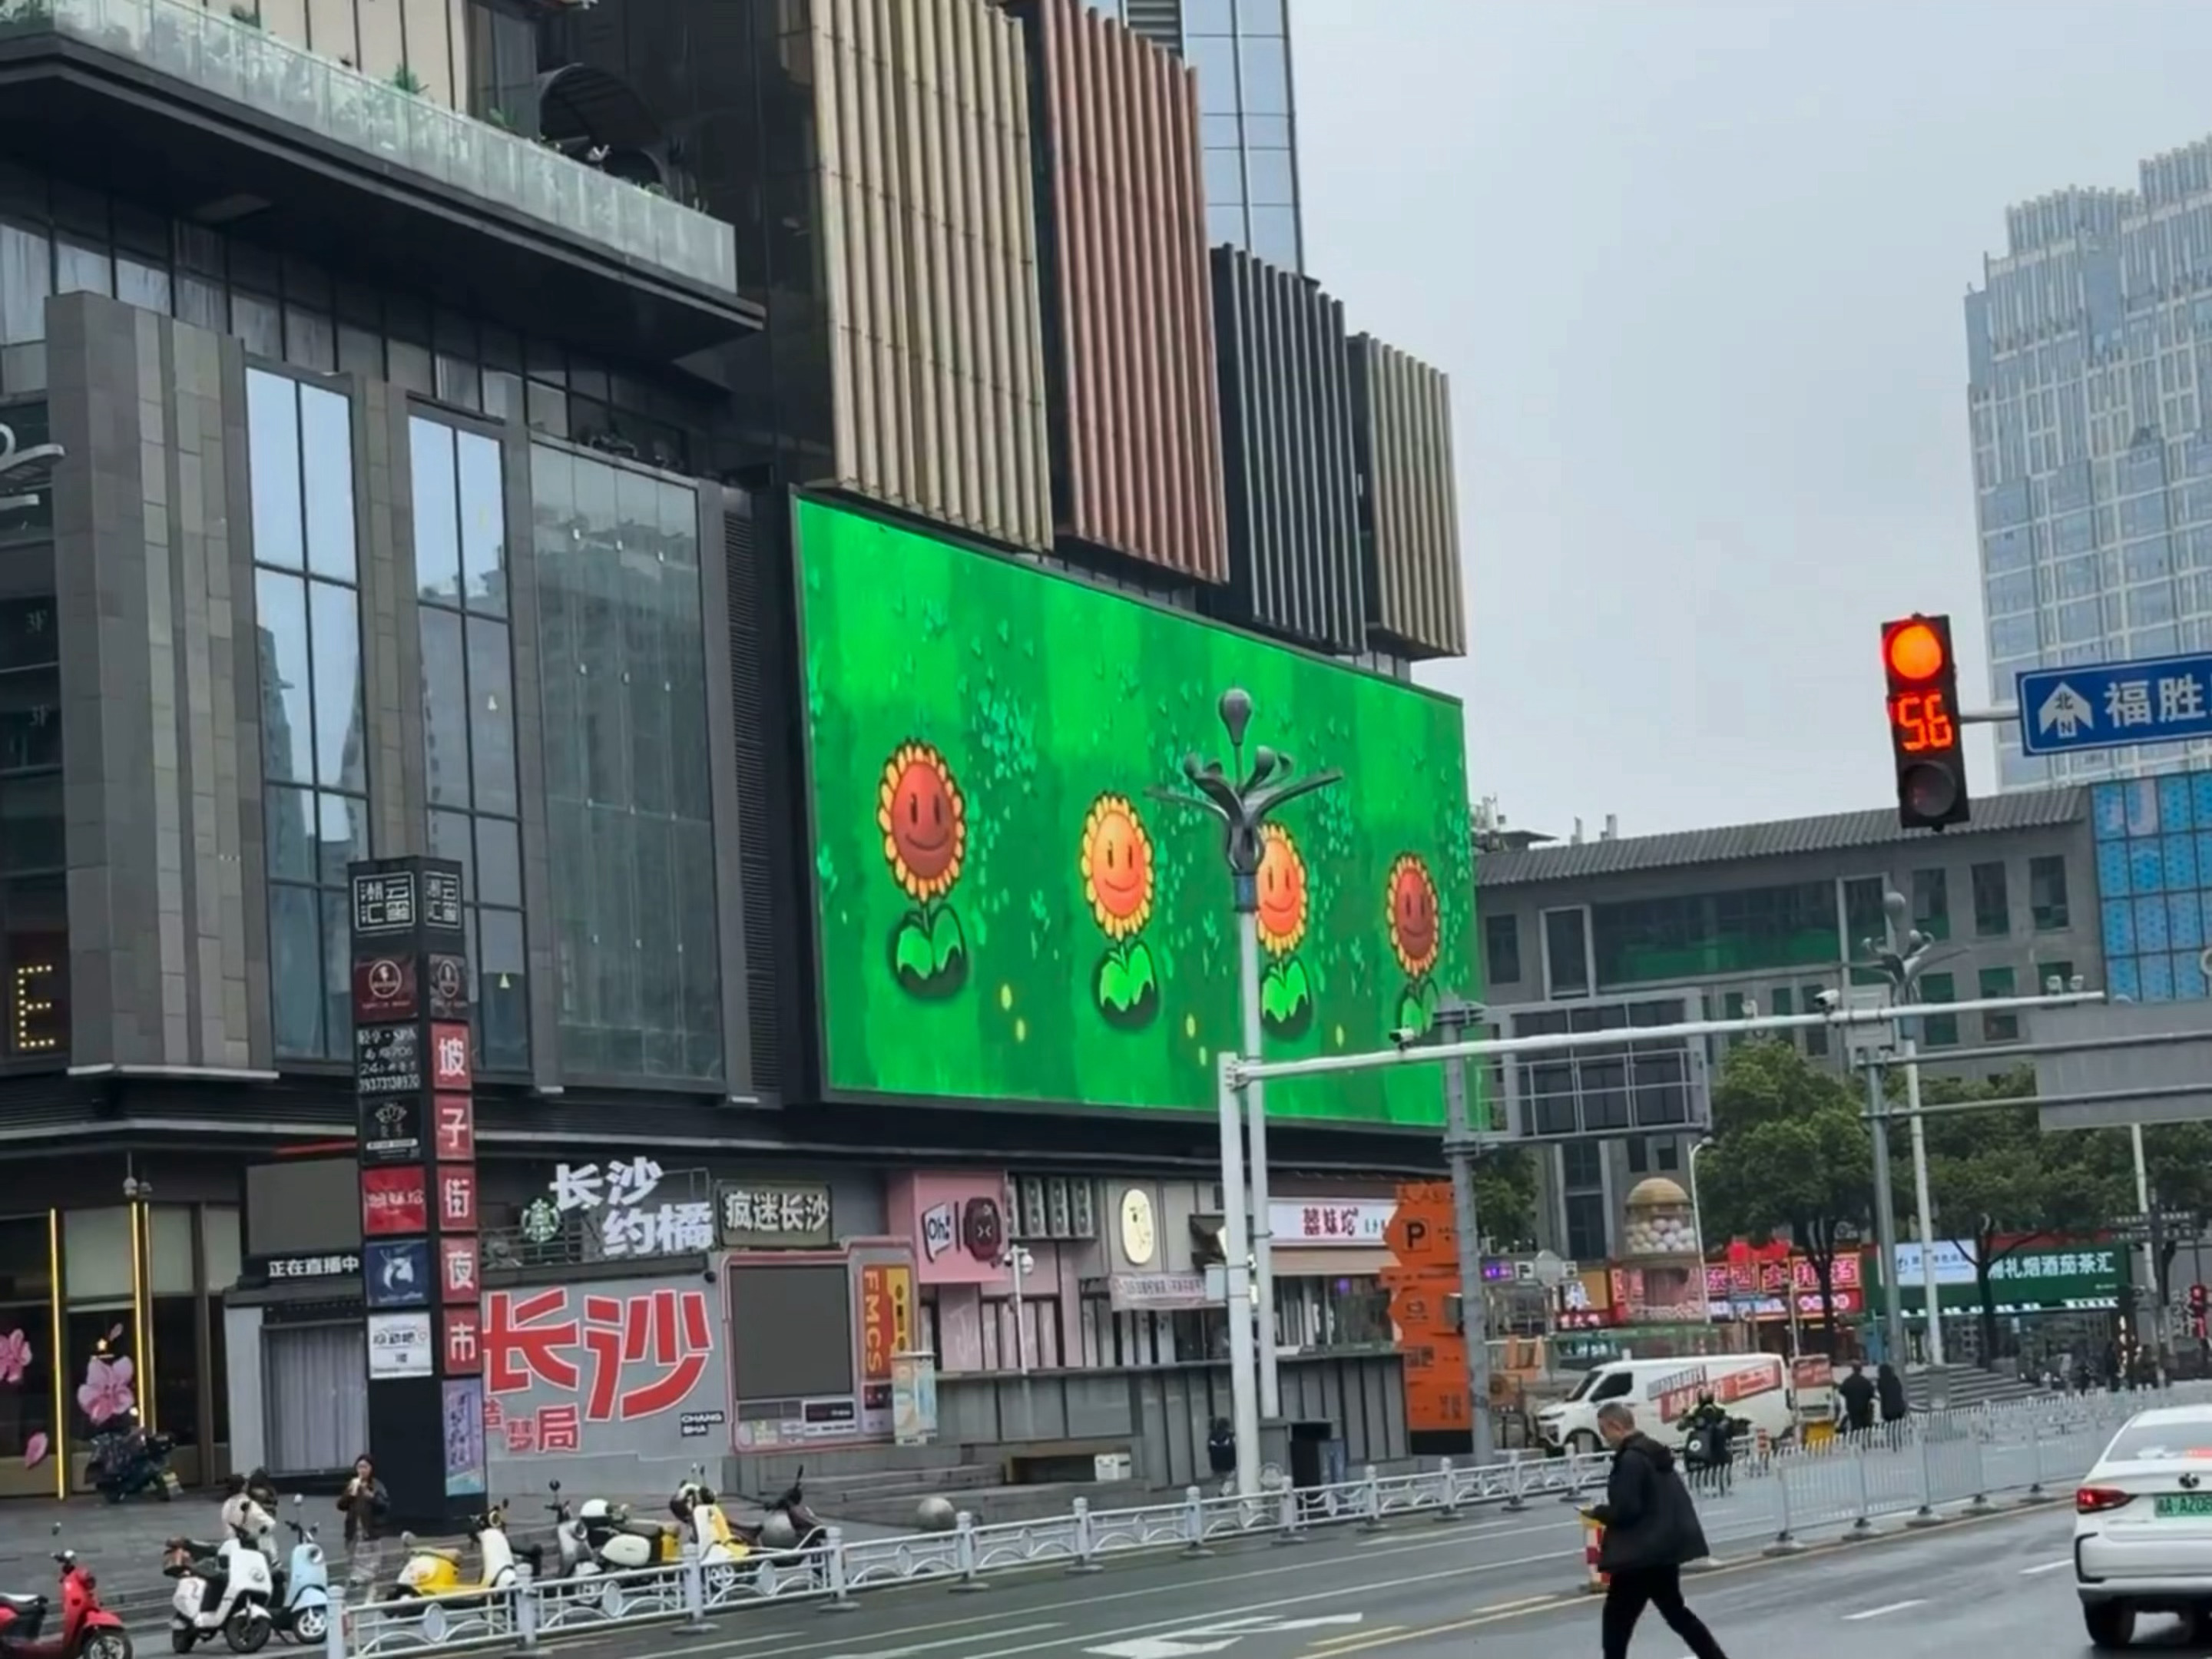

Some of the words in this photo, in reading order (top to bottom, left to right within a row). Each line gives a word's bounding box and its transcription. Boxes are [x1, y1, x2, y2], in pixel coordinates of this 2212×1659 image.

[1897, 693, 1953, 751] 56
[2055, 694, 2073, 710] 北
[2061, 720, 2073, 734] N
[2104, 673, 2212, 728] 福胜
[437, 1036, 475, 1361] 坡子街夜市
[549, 1156, 664, 1211] 长沙
[602, 1201, 714, 1256] 约橘
[724, 1191, 830, 1232] 疯迷长沙
[926, 1216, 951, 1241] Oh!
[1407, 1221, 1426, 1248] P
[269, 1256, 359, 1277] 正在直播中
[864, 1270, 882, 1373] FMCS
[482, 1287, 714, 1422] 长沙
